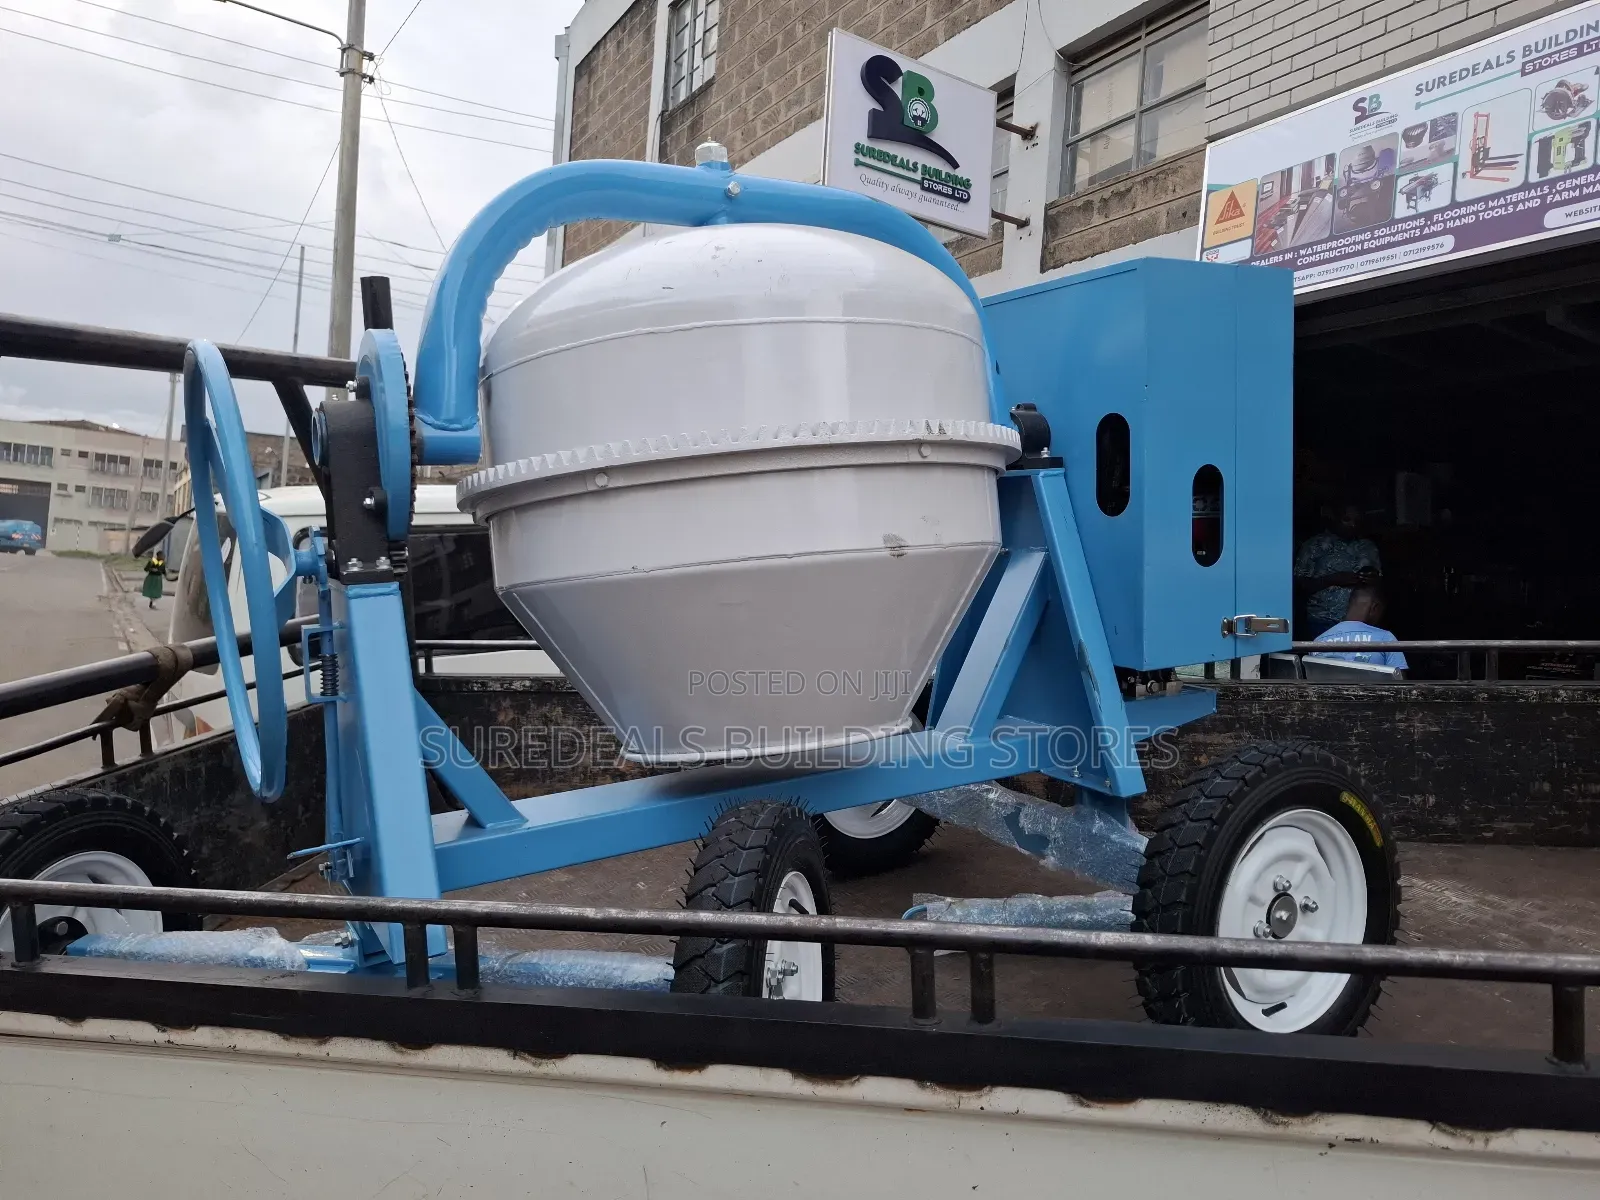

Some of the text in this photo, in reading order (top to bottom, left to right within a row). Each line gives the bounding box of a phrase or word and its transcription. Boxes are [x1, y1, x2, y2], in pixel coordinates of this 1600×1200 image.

[1415, 50, 1515, 97] SUREDEALS
[1525, 40, 1600, 72] STORES LT
[854, 142, 972, 189] SUREDEALS BUILDING
[860, 173, 889, 192] Quality
[891, 184, 917, 199] always
[923, 180, 968, 199] STORES LTD
[1219, 200, 1240, 221] Sika
[1297, 244, 1361, 266] CONSTRUCTION
[1364, 228, 1420, 249] EQUIPMENTS
[1423, 222, 1444, 235] AND
[1446, 215, 1475, 228] HAND
[1479, 205, 1513, 220] TOOLS
[1516, 199, 1540, 211] AND
[1547, 188, 1579, 203] FARM
[1300, 231, 1371, 256] WATERPROOFING
[1374, 218, 1425, 237] SOLUTIONS
[1433, 202, 1485, 222] FLOORING
[1488, 186, 1549, 210] MATERIALS
[1565, 205, 1600, 218] WEBSIT
[1294, 273, 1315, 282] TSAPP:
[1403, 243, 1444, 257] 0712199576
